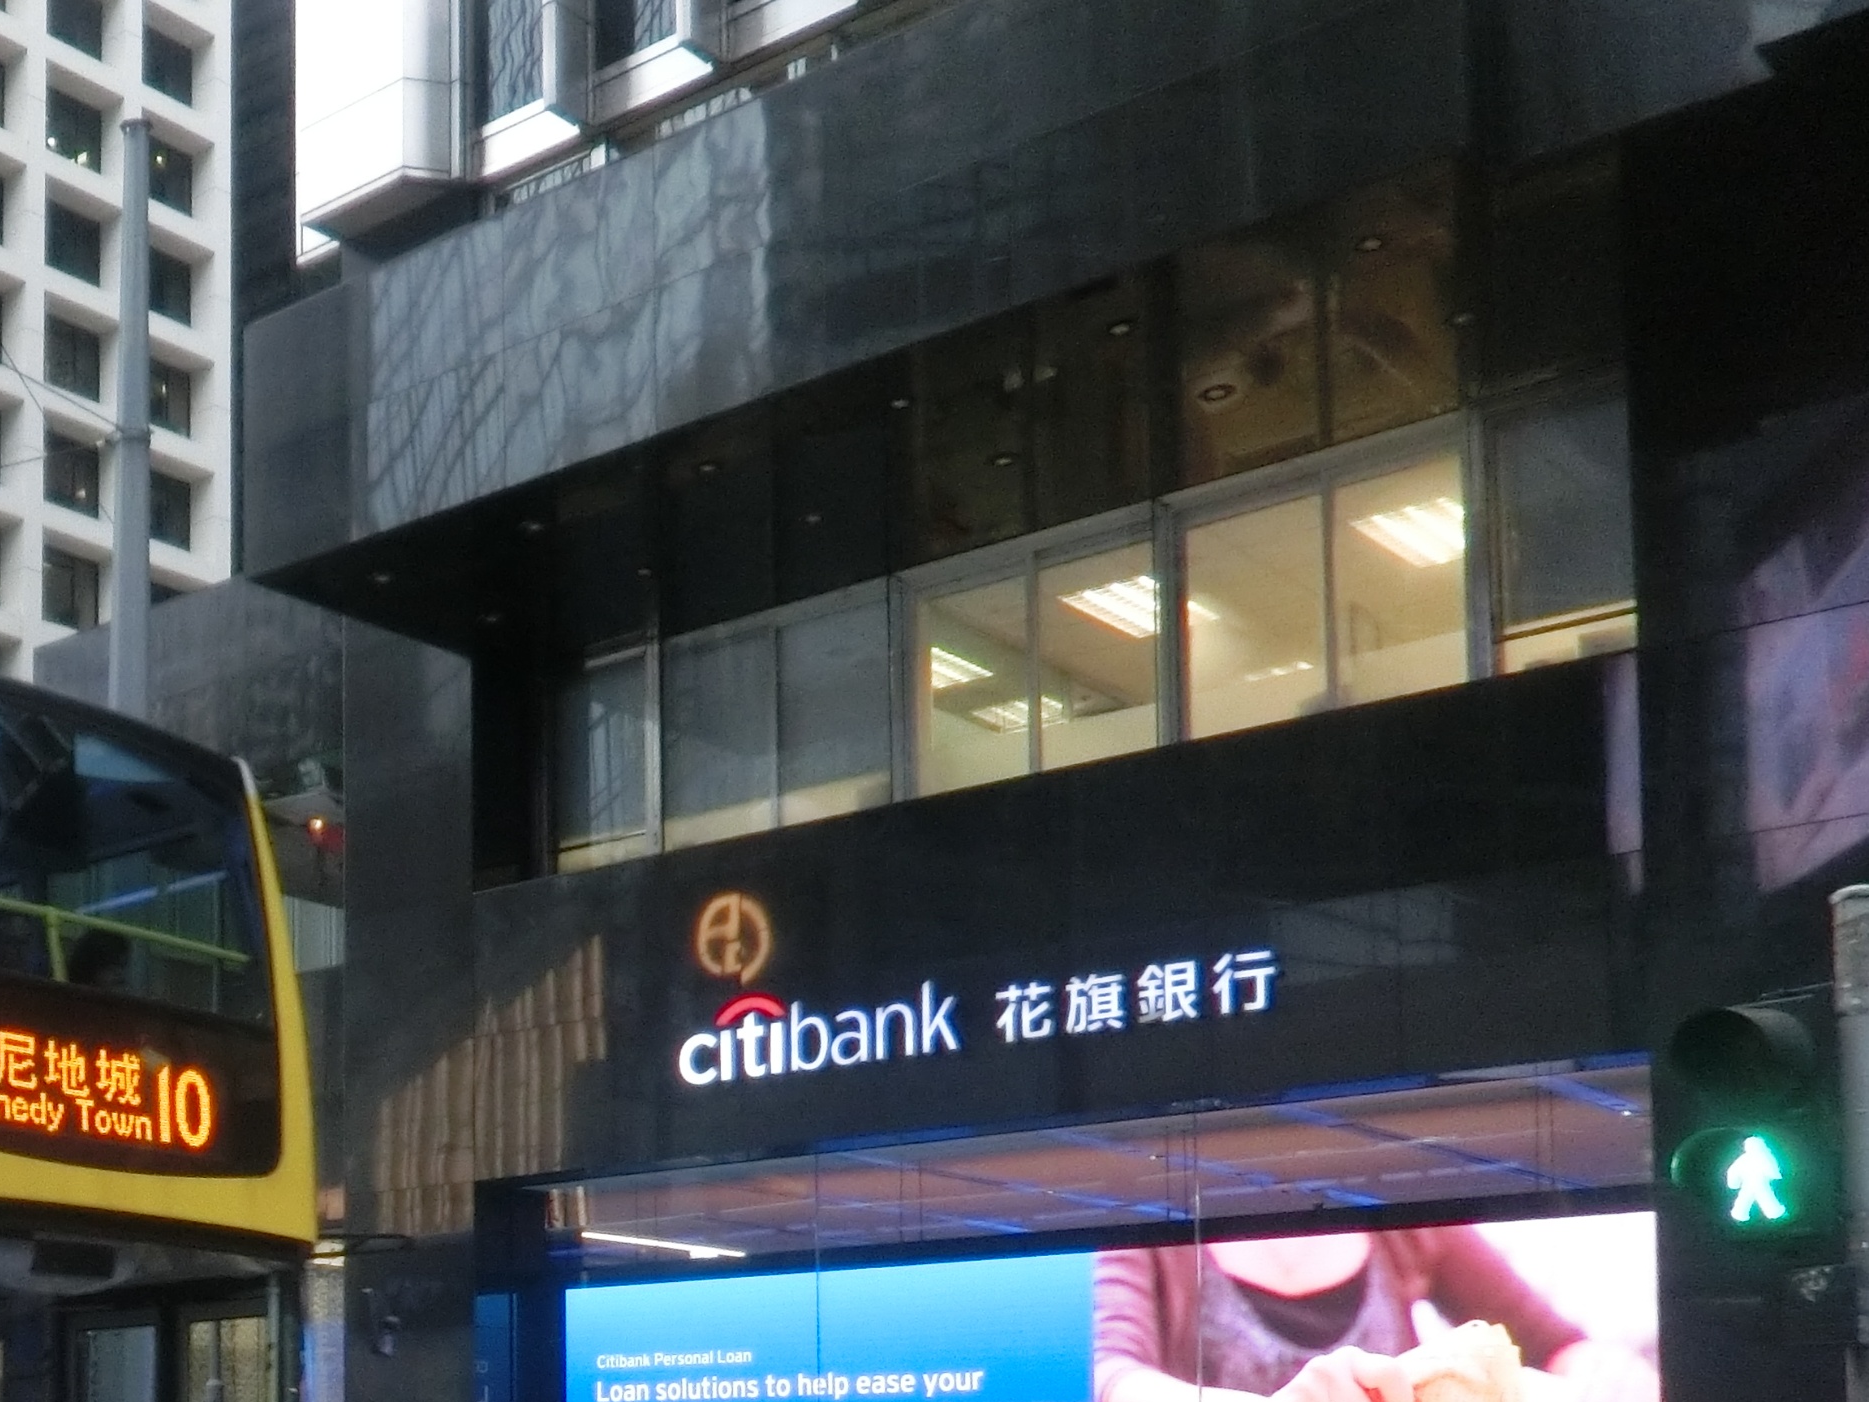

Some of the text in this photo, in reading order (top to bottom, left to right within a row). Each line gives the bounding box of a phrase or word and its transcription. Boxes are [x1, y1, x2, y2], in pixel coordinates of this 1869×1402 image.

[994, 950, 1277, 1043] 花旗銀行
[679, 979, 959, 1085] citibank
[75, 1098, 152, 1141] Town
[157, 1066, 211, 1148] 10
[596, 1350, 752, 1369] Citibank Personal Loan
[596, 1371, 984, 1402] Loan solutions to help ease your
